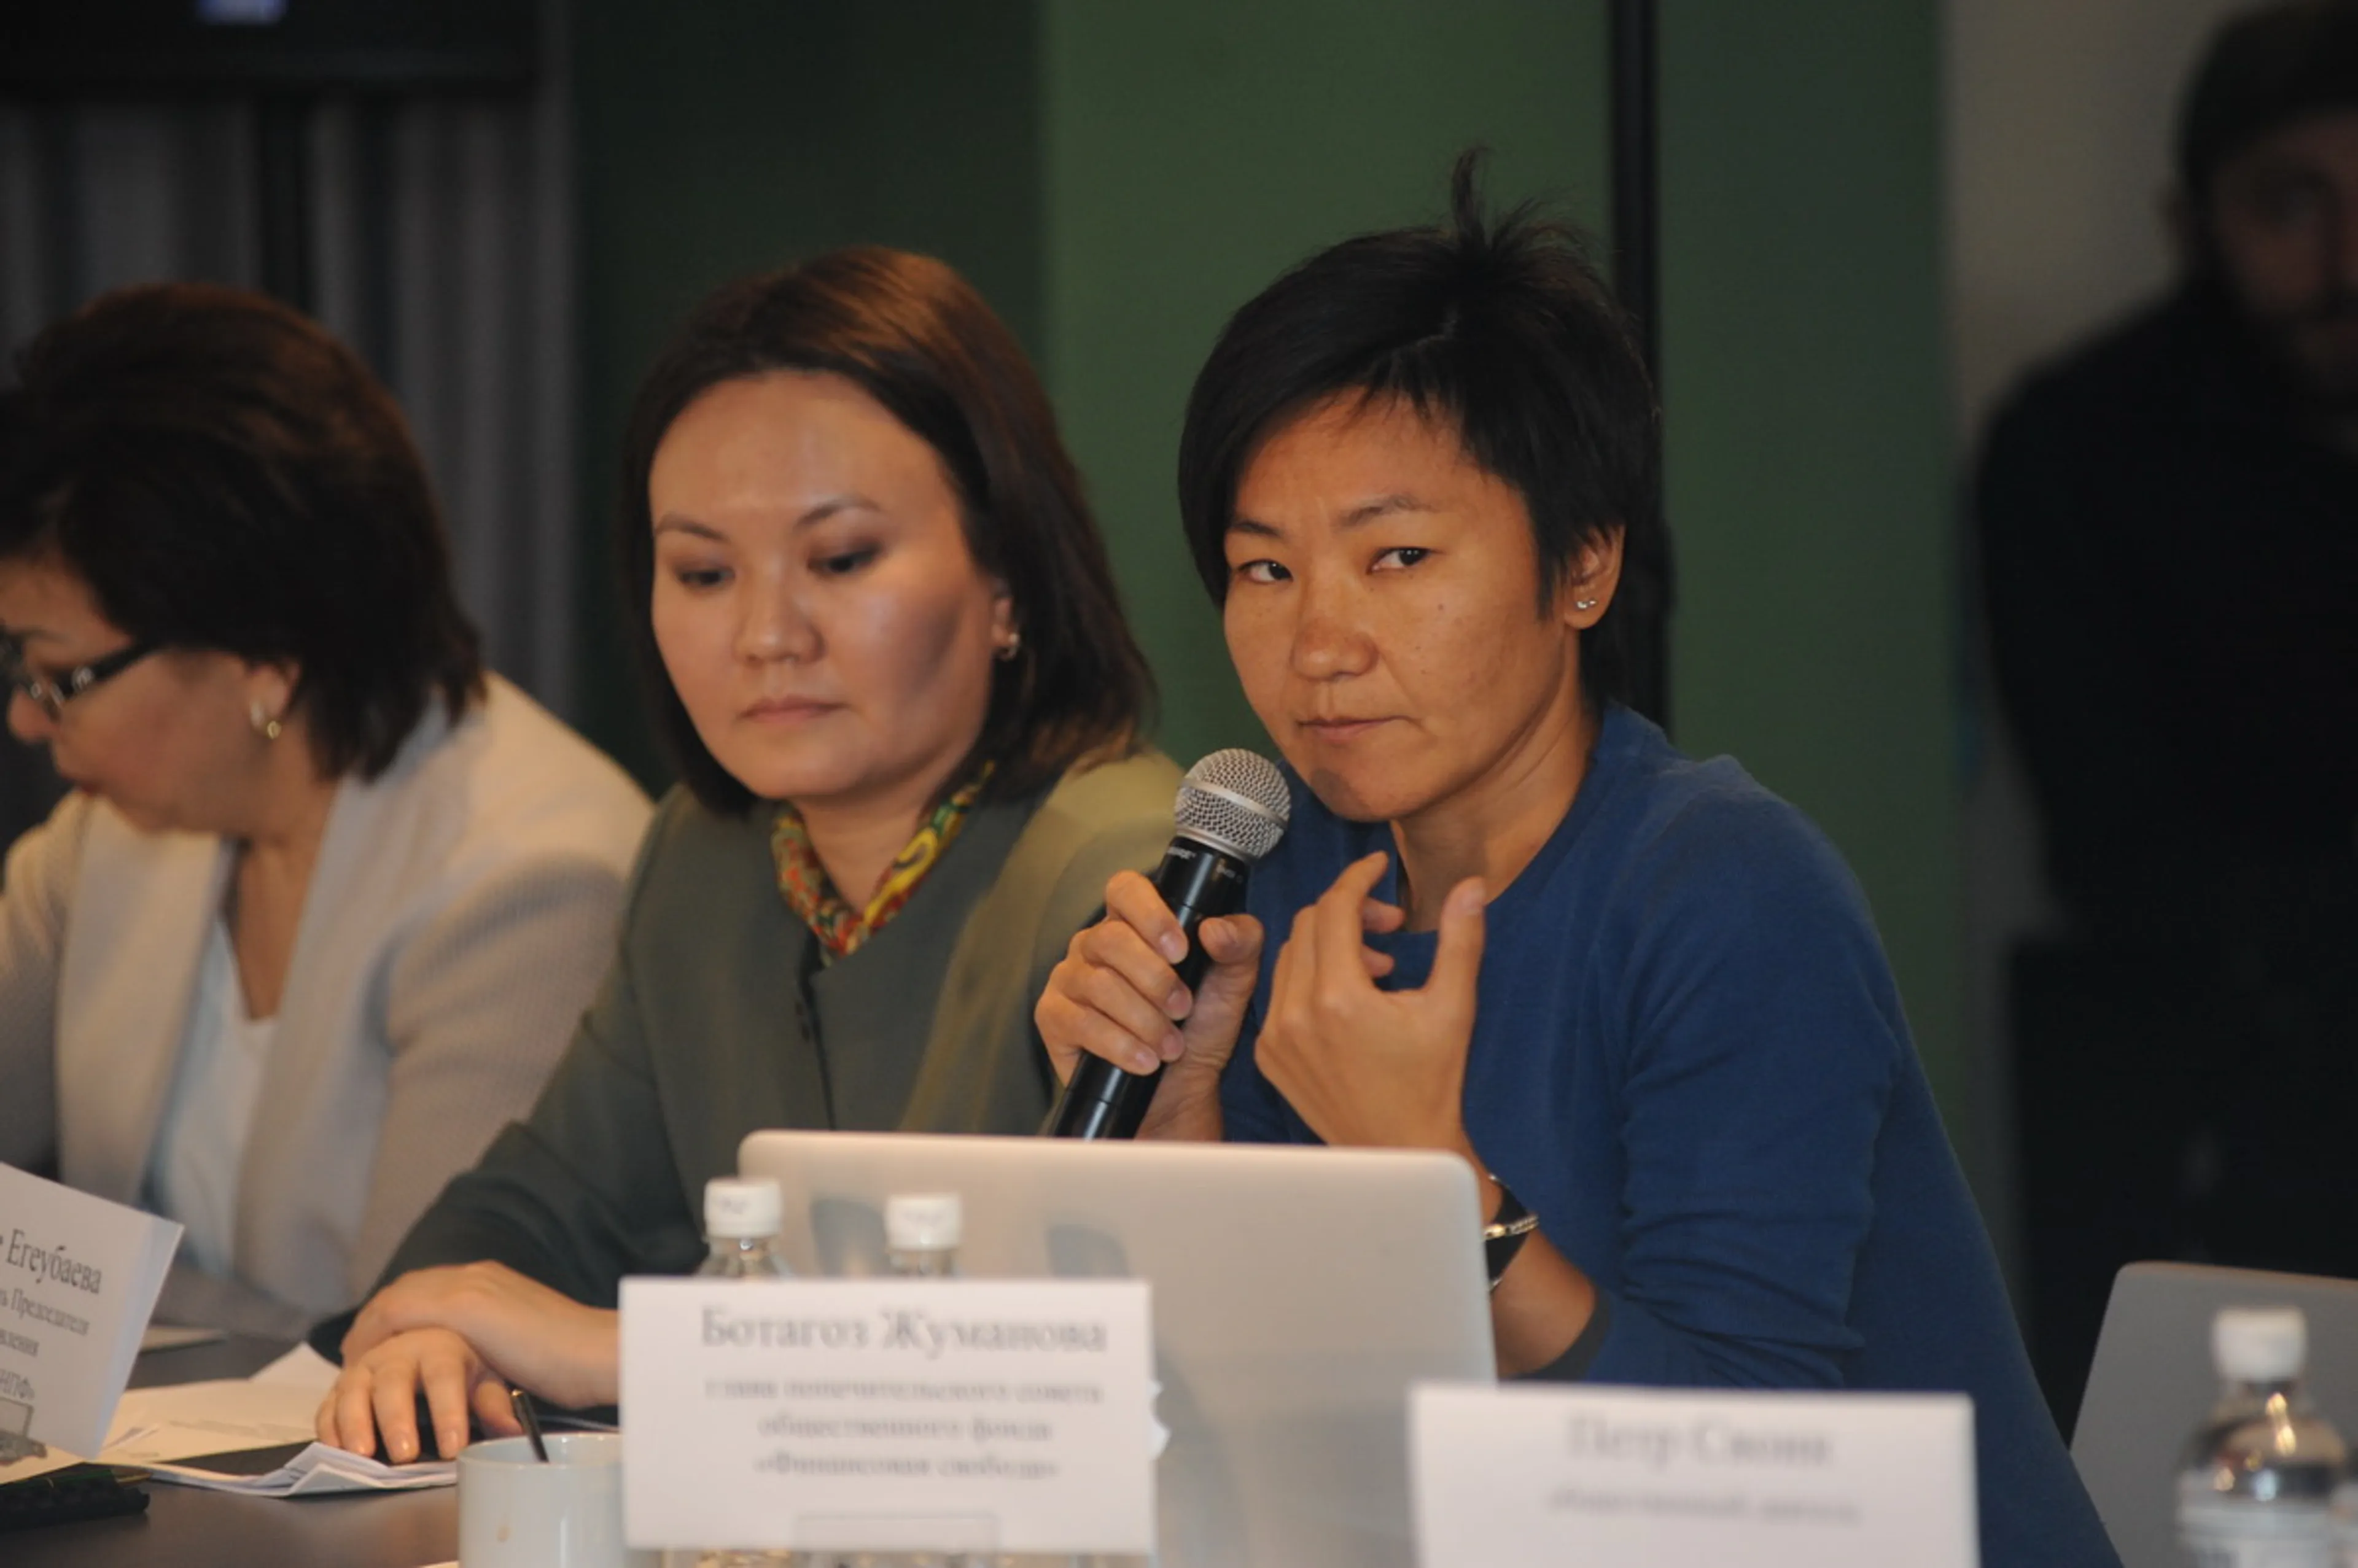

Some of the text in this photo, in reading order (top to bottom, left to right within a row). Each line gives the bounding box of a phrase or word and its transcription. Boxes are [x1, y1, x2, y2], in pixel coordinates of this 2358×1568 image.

[6, 1228, 101, 1294] Егеубаева
[702, 1306, 1107, 1360] Ботагоз Жуманова
